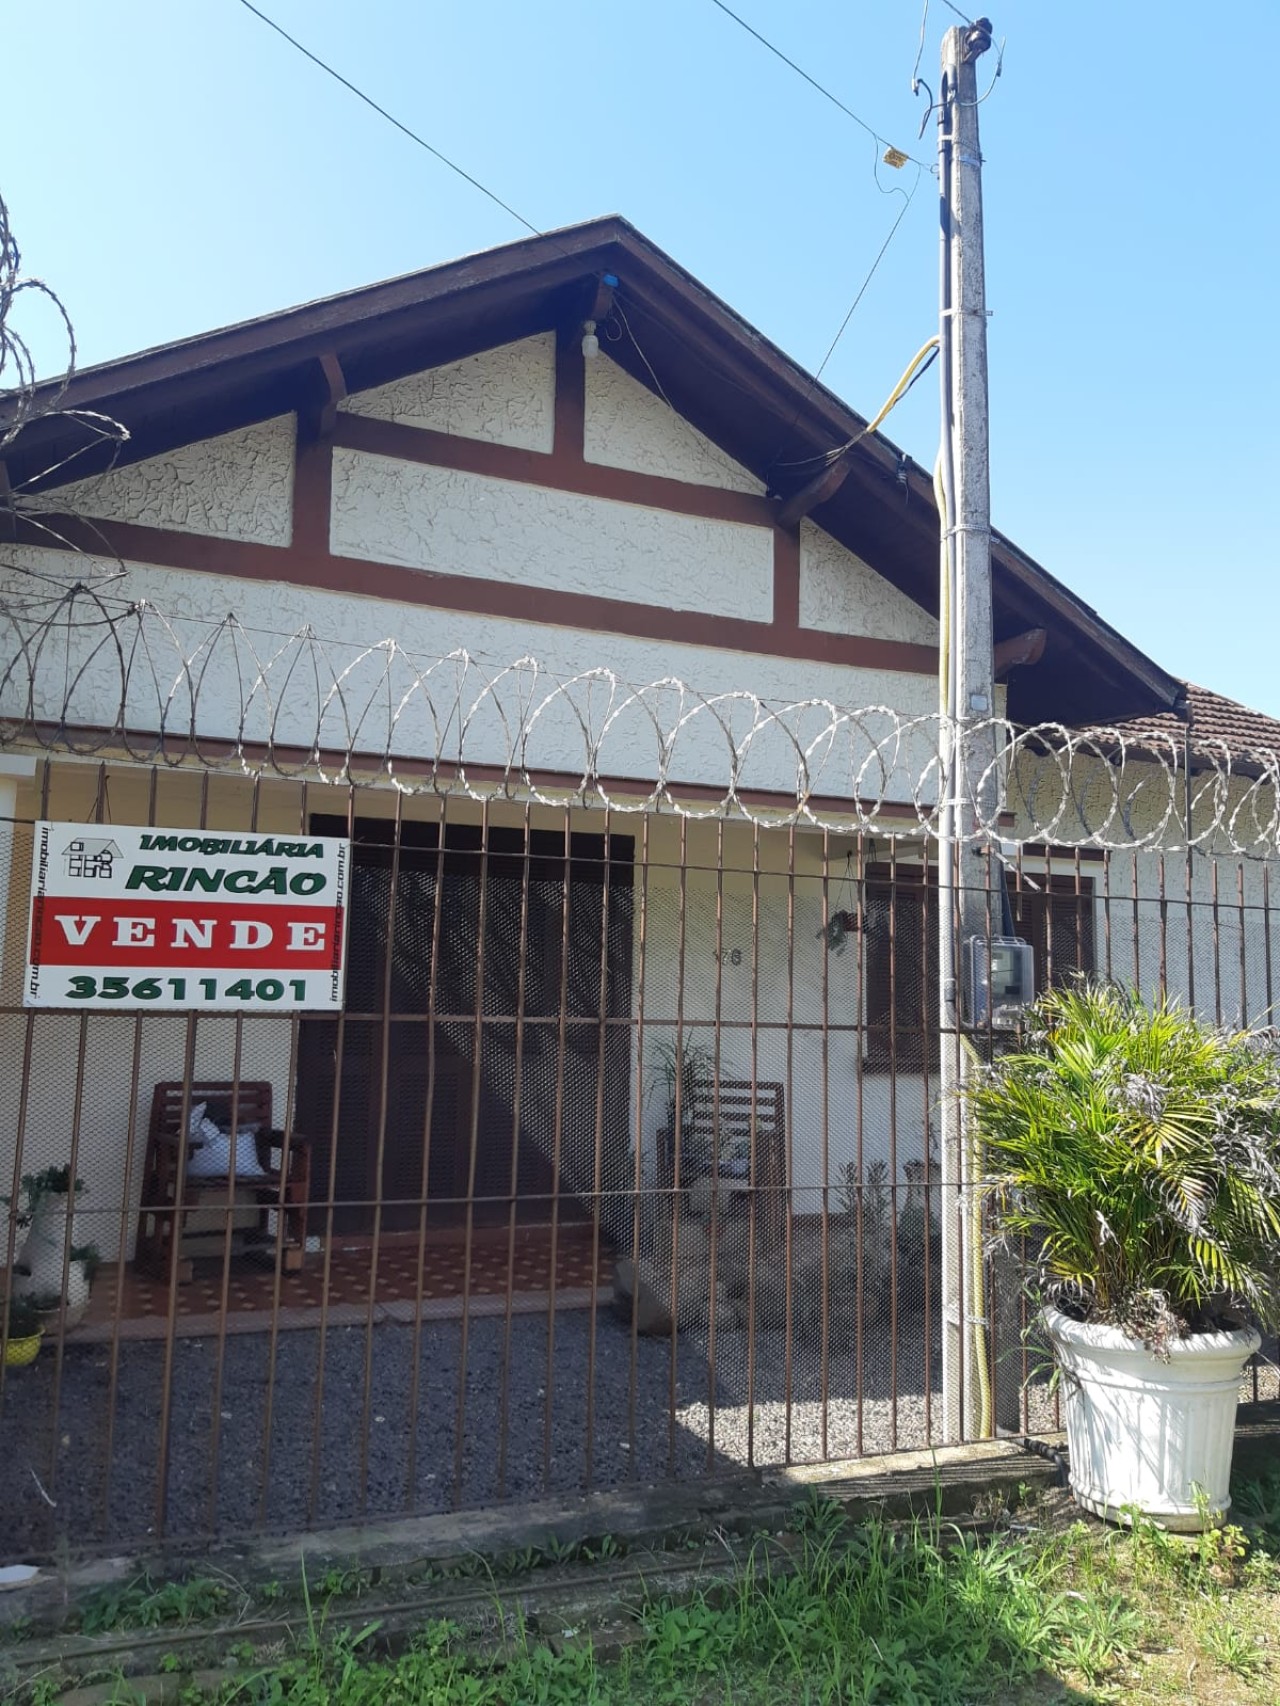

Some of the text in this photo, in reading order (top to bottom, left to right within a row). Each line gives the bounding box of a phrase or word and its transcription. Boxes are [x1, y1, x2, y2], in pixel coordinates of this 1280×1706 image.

[139, 834, 324, 858] IMOBILIÁRIA
[125, 865, 327, 895] RINCÃO
[54, 915, 326, 951] VENDE
[65, 976, 306, 1001] 35611401
